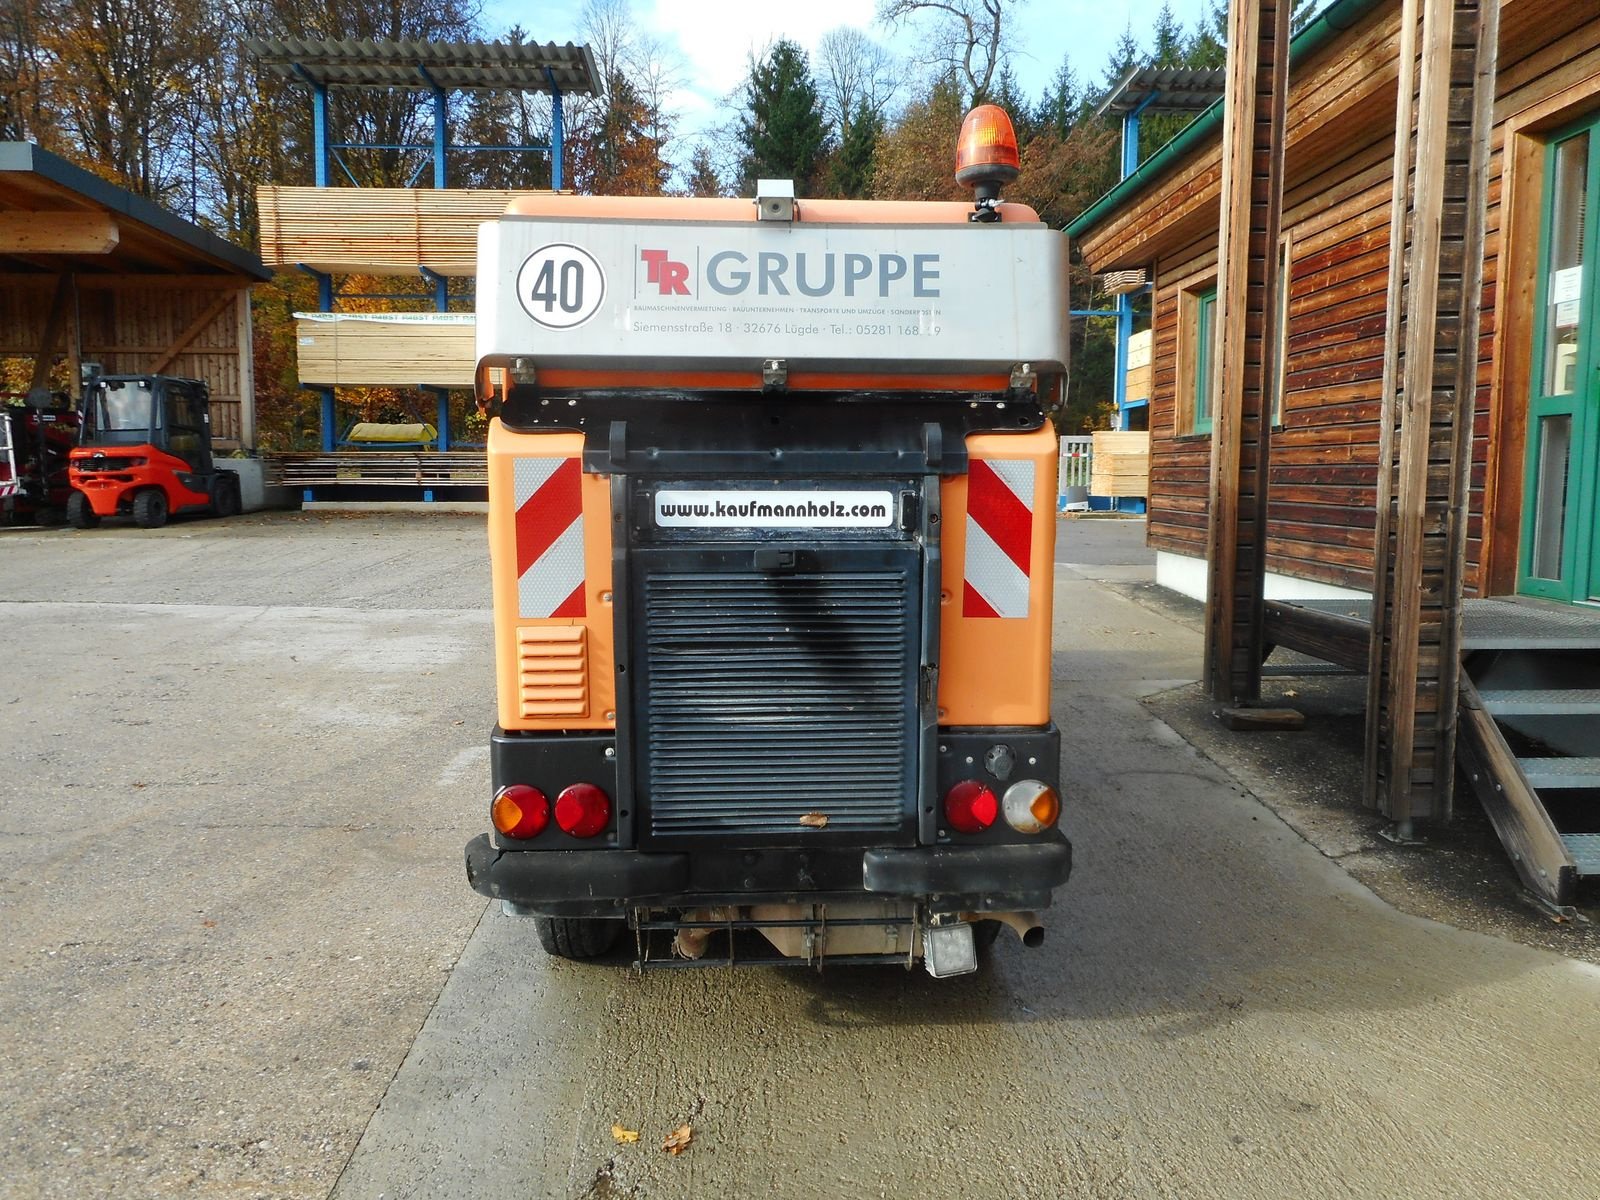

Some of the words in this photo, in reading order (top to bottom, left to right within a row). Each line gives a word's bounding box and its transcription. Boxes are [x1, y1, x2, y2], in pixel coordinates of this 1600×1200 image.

[531, 260, 584, 313] 40
[641, 249, 692, 295] TR
[706, 251, 940, 297] GRUPPE
[633, 322, 713, 332] Siemensstraße
[719, 323, 732, 333] 18
[743, 323, 781, 334] 32676
[785, 323, 819, 336] Lügde
[830, 324, 852, 334] Tel.:
[856, 324, 892, 335] 05281
[661, 500, 886, 517] www.kaufmannholz.com
